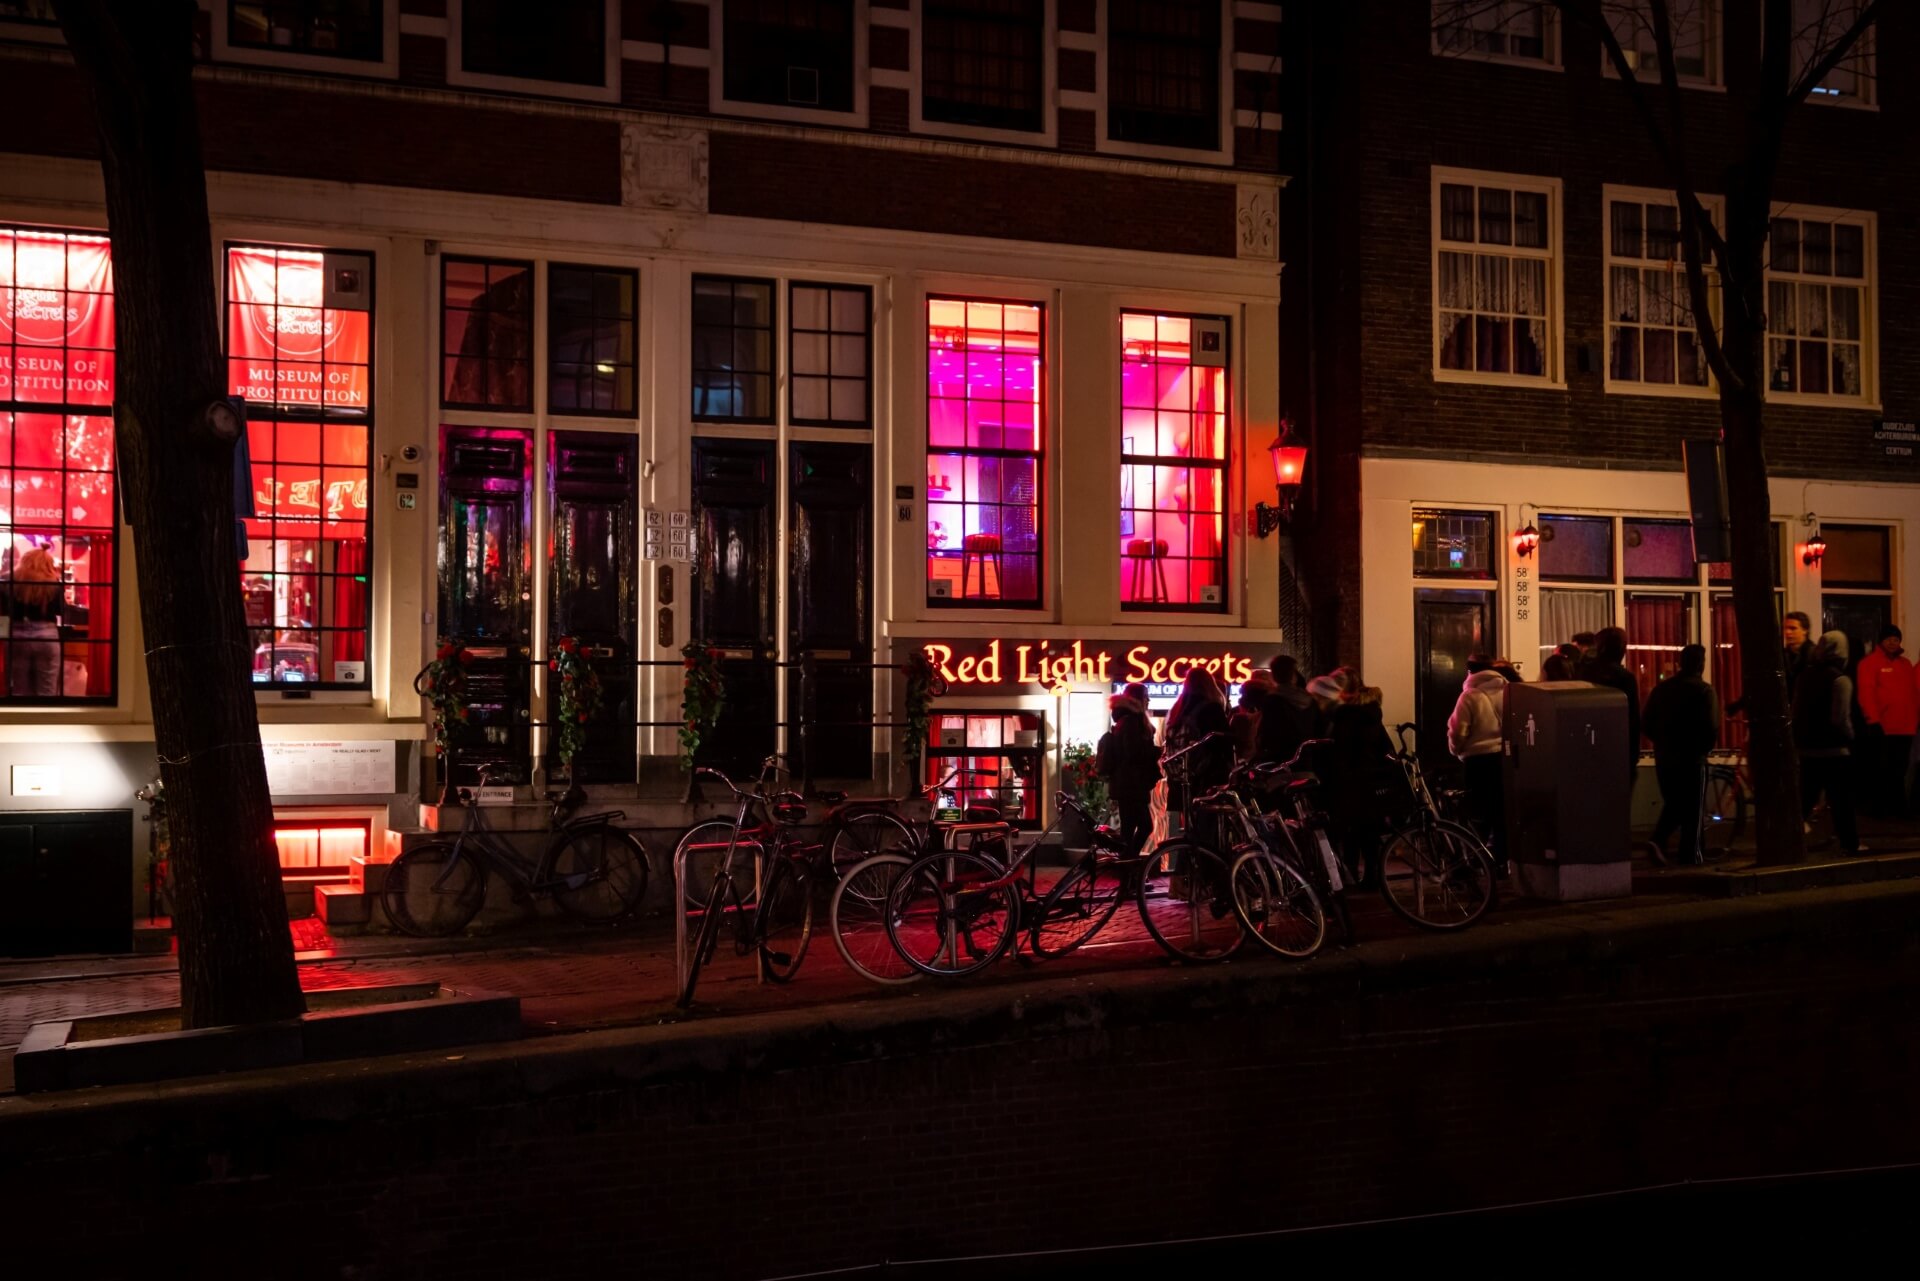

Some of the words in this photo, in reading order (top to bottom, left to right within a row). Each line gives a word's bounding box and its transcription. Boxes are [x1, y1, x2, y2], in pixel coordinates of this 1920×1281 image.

[7, 300, 78, 322] Secrets
[266, 315, 333, 335] Secrets
[0, 356, 63, 371] USEUM
[74, 360, 97, 373] OF
[248, 368, 322, 383] MUSEUM
[328, 371, 349, 384] OF
[236, 385, 362, 402] PROSTITUTION
[399, 494, 413, 509] 62
[673, 513, 683, 525] 60
[899, 504, 911, 520] 60
[922, 639, 1001, 684] Red
[1016, 640, 1112, 697] Light
[1125, 645, 1253, 685] Secrets
